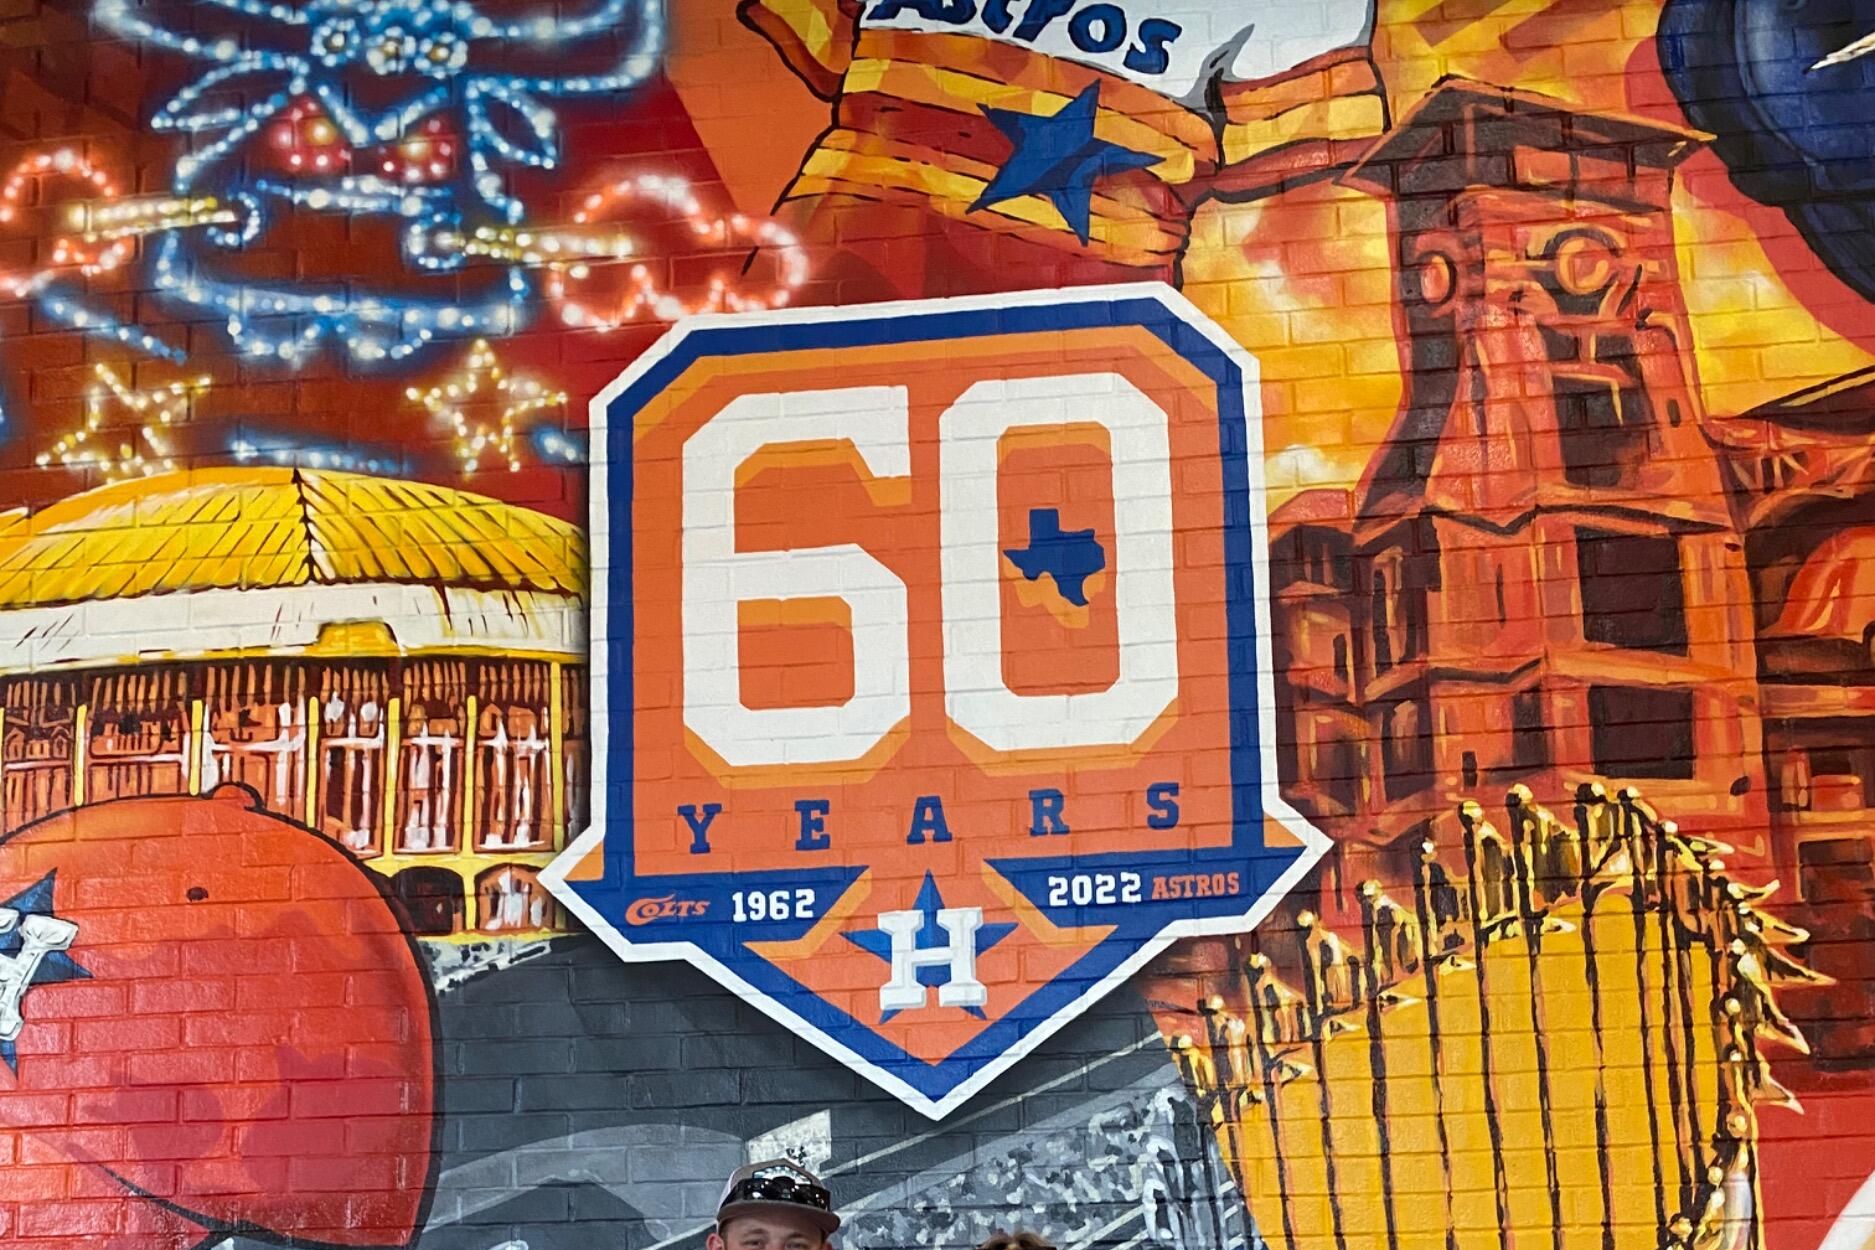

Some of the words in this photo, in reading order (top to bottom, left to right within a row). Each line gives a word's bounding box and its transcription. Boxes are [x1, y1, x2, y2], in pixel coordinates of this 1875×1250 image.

[682, 372, 1179, 767] 60
[678, 783, 1180, 854] YEARS
[732, 888, 816, 923] 1962
[1048, 871, 1143, 907] 2022
[1152, 872, 1240, 900] ASTROS
